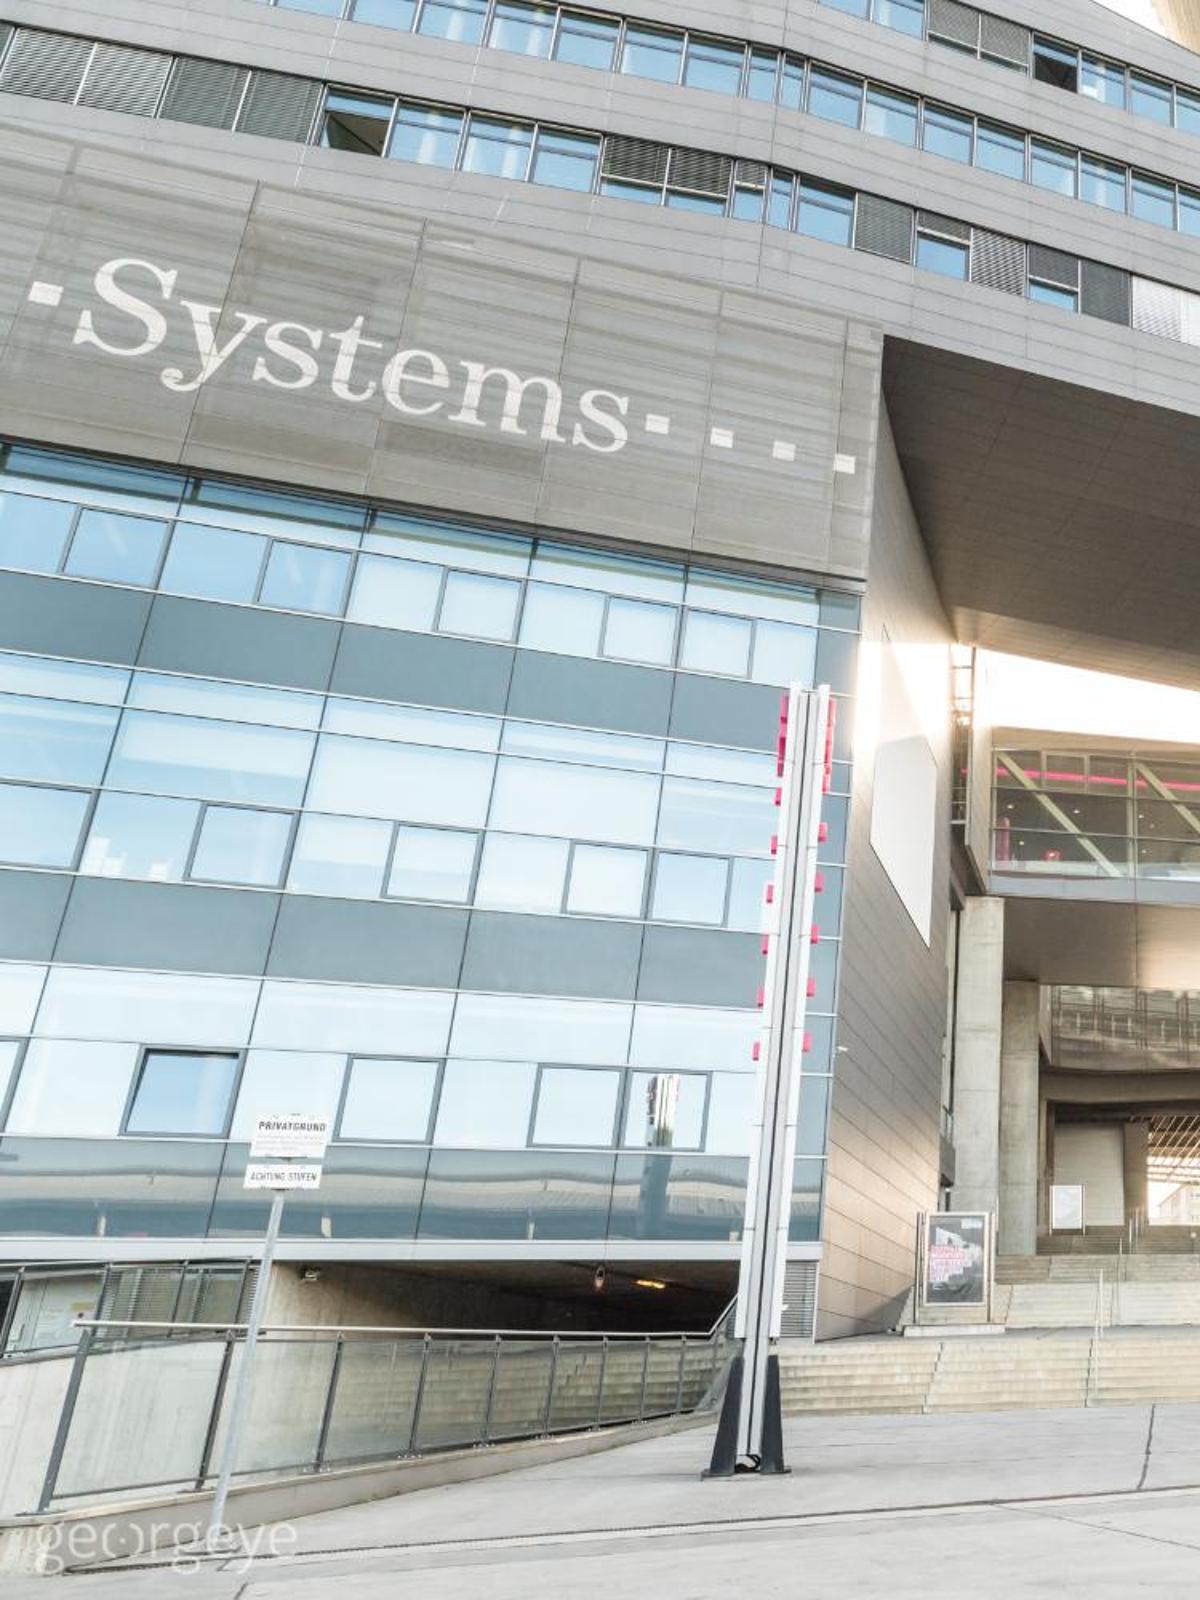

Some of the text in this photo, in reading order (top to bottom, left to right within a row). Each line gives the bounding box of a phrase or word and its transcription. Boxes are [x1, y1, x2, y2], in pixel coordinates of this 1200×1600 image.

[74, 257, 629, 454] Systems
[258, 1120, 327, 1132] PRIVATGRUND
[250, 1171, 318, 1182] ACHTUNG STUFEN
